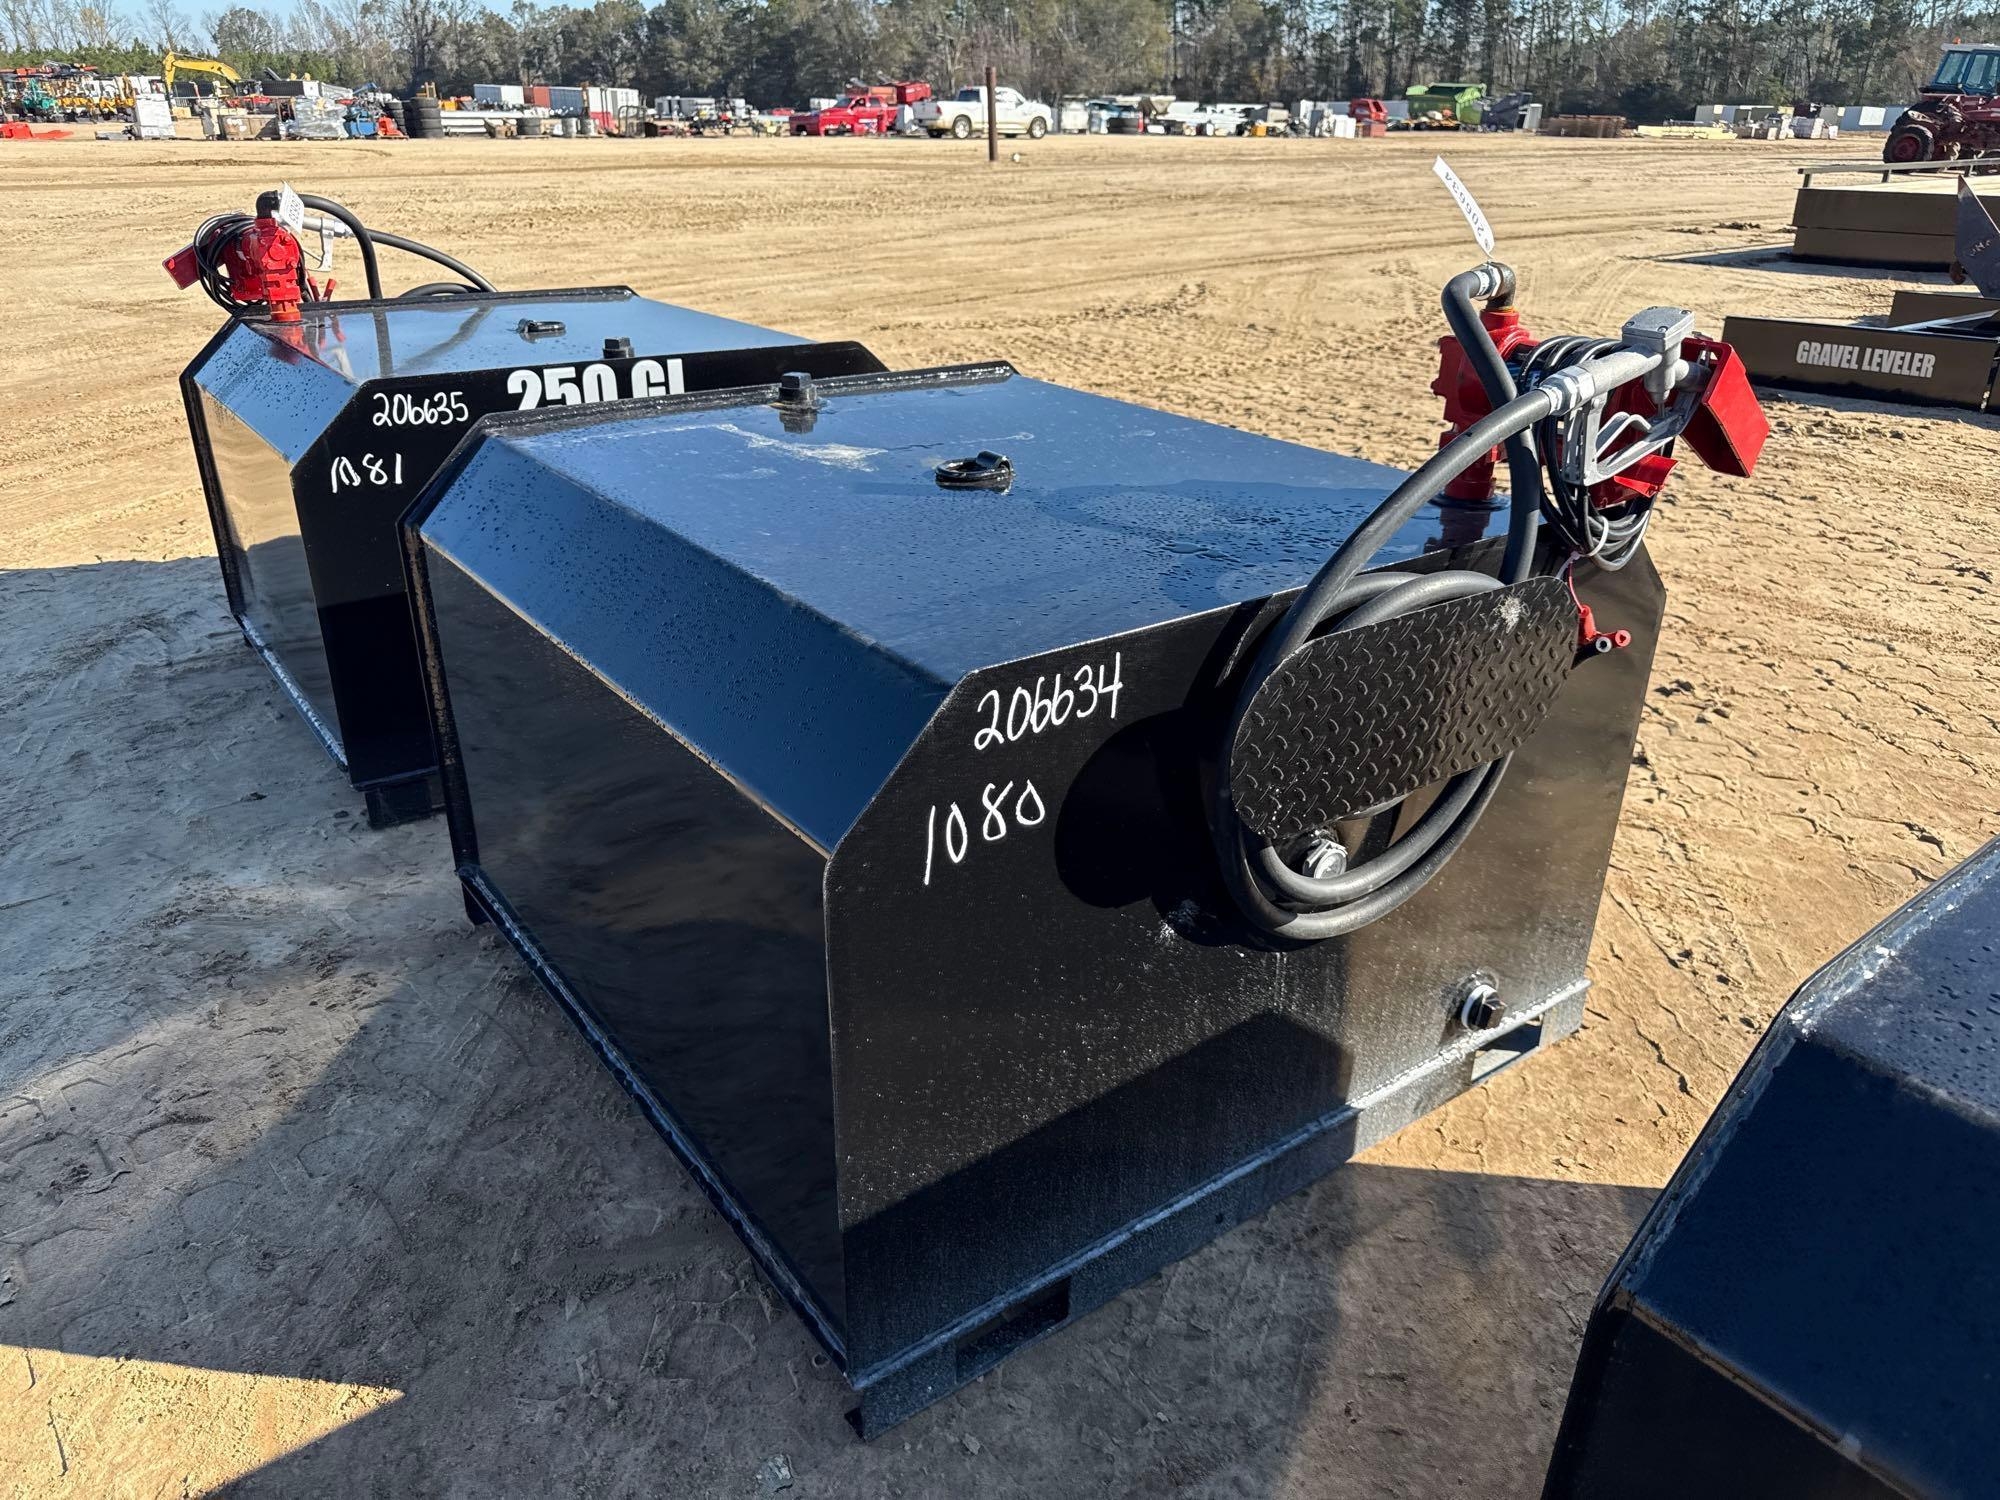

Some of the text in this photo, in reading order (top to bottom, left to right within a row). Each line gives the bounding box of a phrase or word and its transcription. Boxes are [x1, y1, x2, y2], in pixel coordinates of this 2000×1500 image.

[1444, 171, 1485, 237] 206634
[507, 363, 619, 411] 250
[1796, 341, 1936, 378] GRAVEL LEVELER
[372, 391, 469, 427] 206635
[974, 651, 1123, 751] 206634
[924, 779, 1046, 886] 1080
